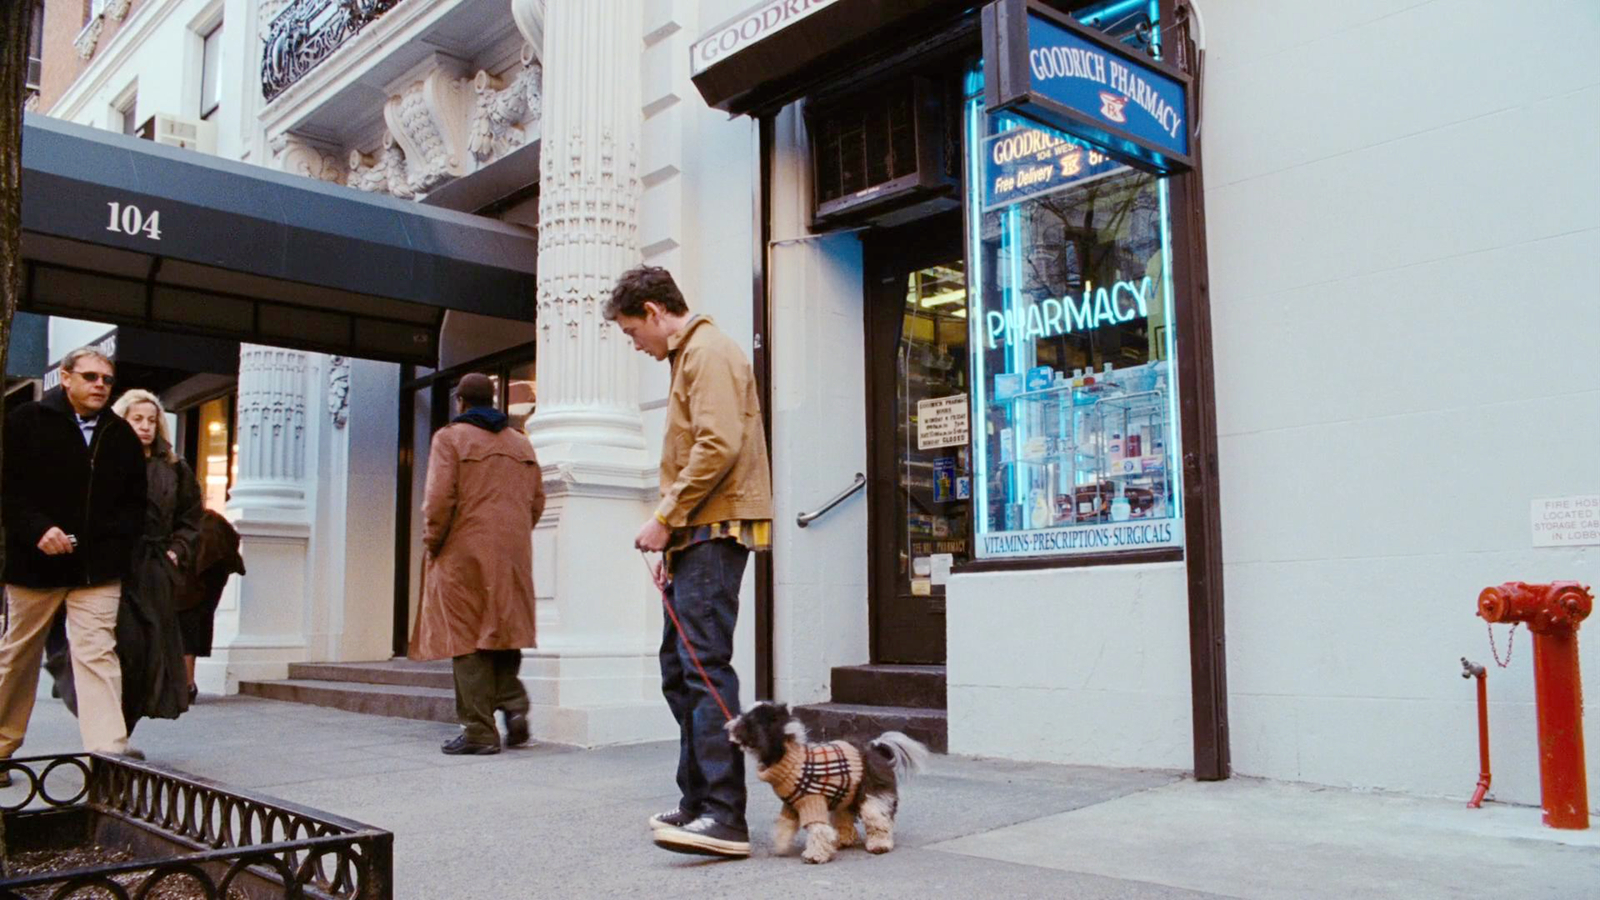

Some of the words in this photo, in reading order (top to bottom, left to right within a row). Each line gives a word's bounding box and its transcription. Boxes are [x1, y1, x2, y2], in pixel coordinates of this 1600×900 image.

[701, 0, 826, 61] GOODRI
[1029, 46, 1106, 84] GOODRICH
[1109, 60, 1182, 139] PHARMACY
[1036, 149, 1052, 161] 104
[995, 177, 1015, 194] Free
[1016, 164, 1054, 188] Delivery
[106, 202, 162, 240] 104
[987, 276, 1151, 349] PHARMACY
[1543, 509, 1593, 520] LOCATED
[1545, 500, 1570, 509] FIRE
[1575, 498, 1600, 507] HOS
[984, 533, 1030, 554] VITAMINS
[1033, 528, 1110, 552] PRESCRIPTIONS
[1113, 523, 1172, 546] SURGICALS
[1534, 520, 1577, 531] STORAGE
[1552, 532, 1563, 540] IN
